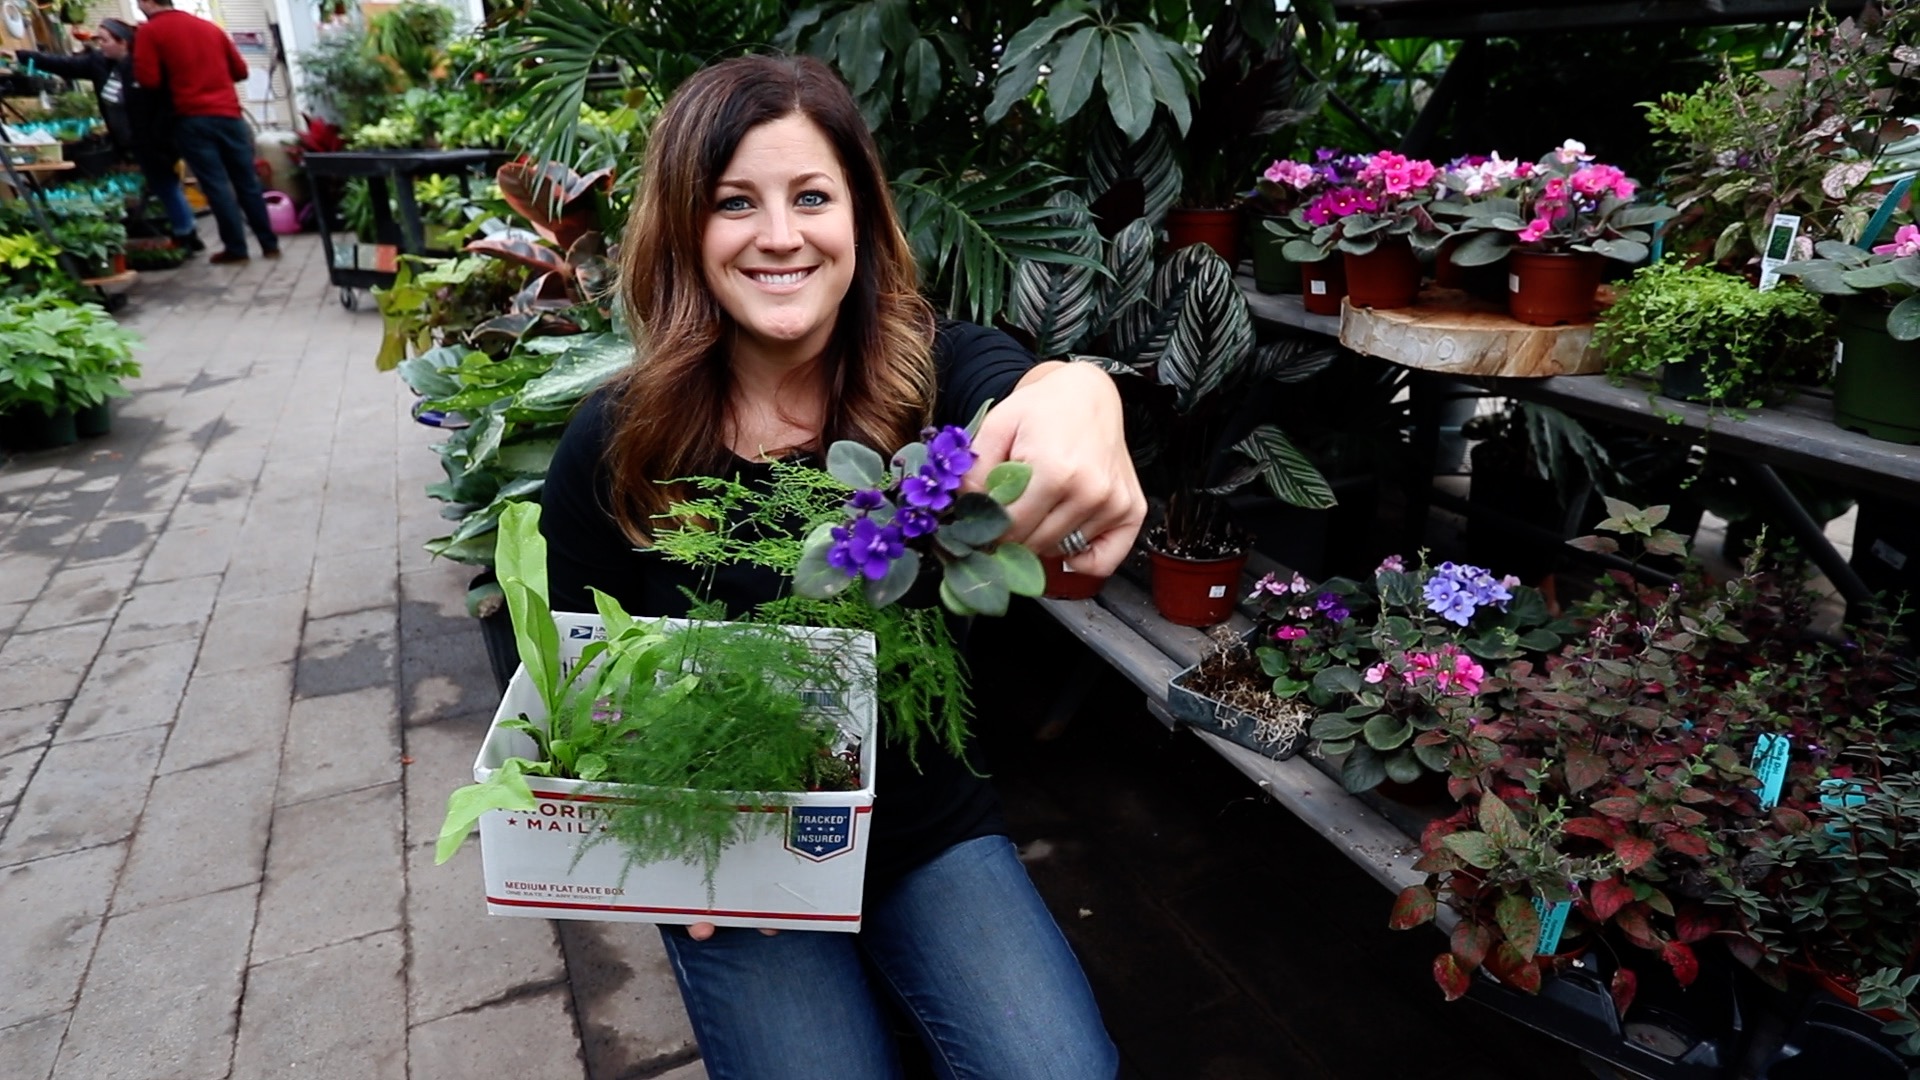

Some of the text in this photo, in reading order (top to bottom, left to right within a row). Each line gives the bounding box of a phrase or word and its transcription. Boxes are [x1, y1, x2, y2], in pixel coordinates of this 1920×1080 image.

[497, 802, 618, 820] ORITY
[527, 819, 591, 834] MAIL
[505, 881, 625, 896] MEDIUM FLAT RATE BOX
